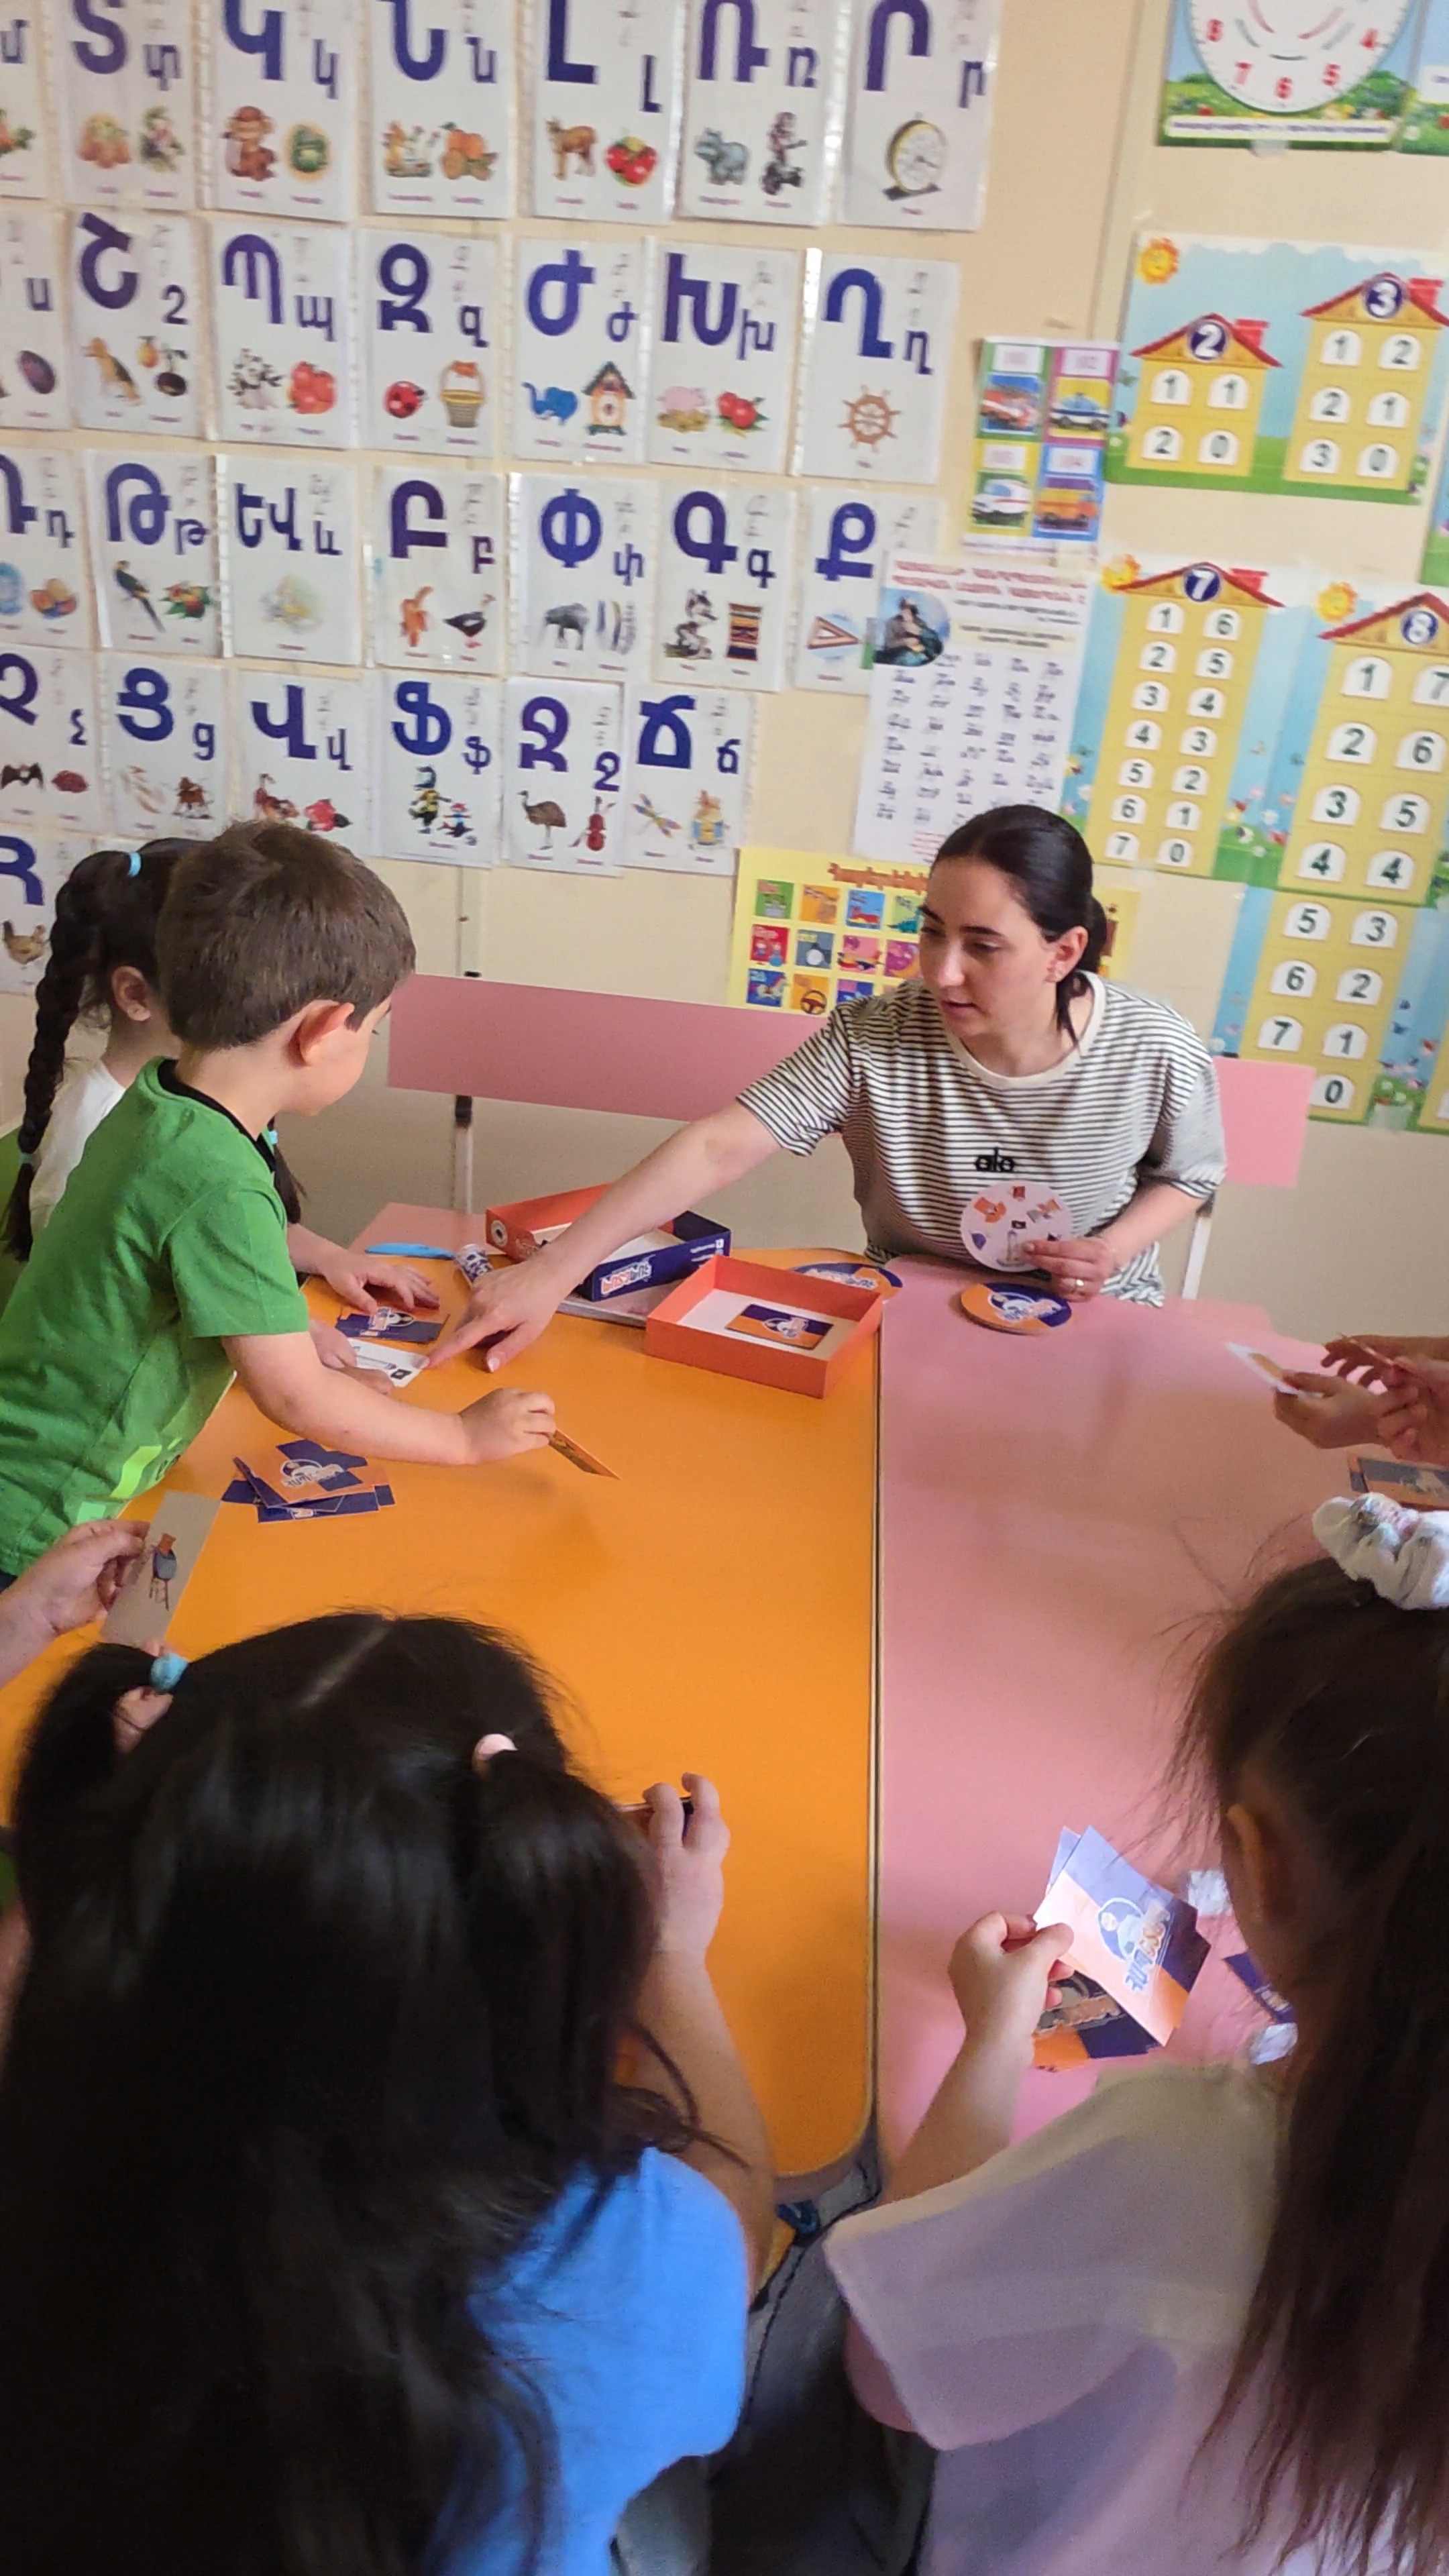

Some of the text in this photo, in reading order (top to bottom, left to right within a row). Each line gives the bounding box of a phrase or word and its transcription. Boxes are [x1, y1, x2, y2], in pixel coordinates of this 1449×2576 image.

[72, 0, 180, 91] Տ տ
[223, 0, 336, 99] Կ կ
[380, 0, 496, 83] Ն ն
[546, 0, 660, 113] Լ լ
[698, 0, 816, 88] Ռ ռ
[865, 0, 984, 109] Ր ր
[1235, 62, 1252, 85] 7
[1324, 64, 1340, 86] 5
[78, 212, 187, 325] Շ շ
[27, 278, 52, 312] ս
[223, 233, 334, 342] Պ պ
[378, 243, 488, 348] Զ զ
[527, 250, 636, 343] Ժ ժ
[1370, 282, 1397, 316] 3
[661, 252, 775, 361] Խ խ
[823, 268, 932, 375] Ղ ղ
[1195, 324, 1222, 357] 2
[1334, 335, 1411, 365] 1 2
[1163, 376, 1238, 405] 1 1
[1322, 392, 1397, 422] 2 1
[1155, 431, 1228, 459] 2 0
[1312, 443, 1387, 472] 3 0
[105, 463, 209, 555] Թ թ
[390, 480, 494, 574] Բ բ
[46, 510, 74, 548] դ
[540, 488, 643, 586] Փ փ
[673, 490, 775, 589] Գ գ
[815, 502, 876, 582] Ք
[1191, 570, 1215, 600] 7
[1160, 608, 1233, 635] 1 6
[1409, 612, 1432, 643] 8
[1149, 646, 1224, 674] 2 5
[1142, 685, 1214, 712] 3 4
[1361, 663, 1449, 700] 1 7
[70, 708, 87, 746] չ
[117, 667, 215, 761] Ց ց
[250, 684, 352, 771] Վ վ
[392, 681, 491, 775] Ֆ ֆ
[519, 696, 621, 792] Ջ ջ
[637, 694, 740, 774] Ճ ճ
[1135, 726, 1208, 752] 4 3
[1342, 728, 1434, 764] 2 6
[1129, 763, 1200, 790] 5 2
[1122, 798, 1191, 826] 6 1
[1326, 790, 1417, 828] 3 5
[1117, 835, 1185, 863] 7 0
[1311, 849, 1401, 883] 4 4
[1298, 908, 1387, 942] 5 3
[1286, 966, 1371, 999] 6 2
[1274, 1021, 1353, 1055] 7 1
[1324, 1080, 1344, 1104] 0
